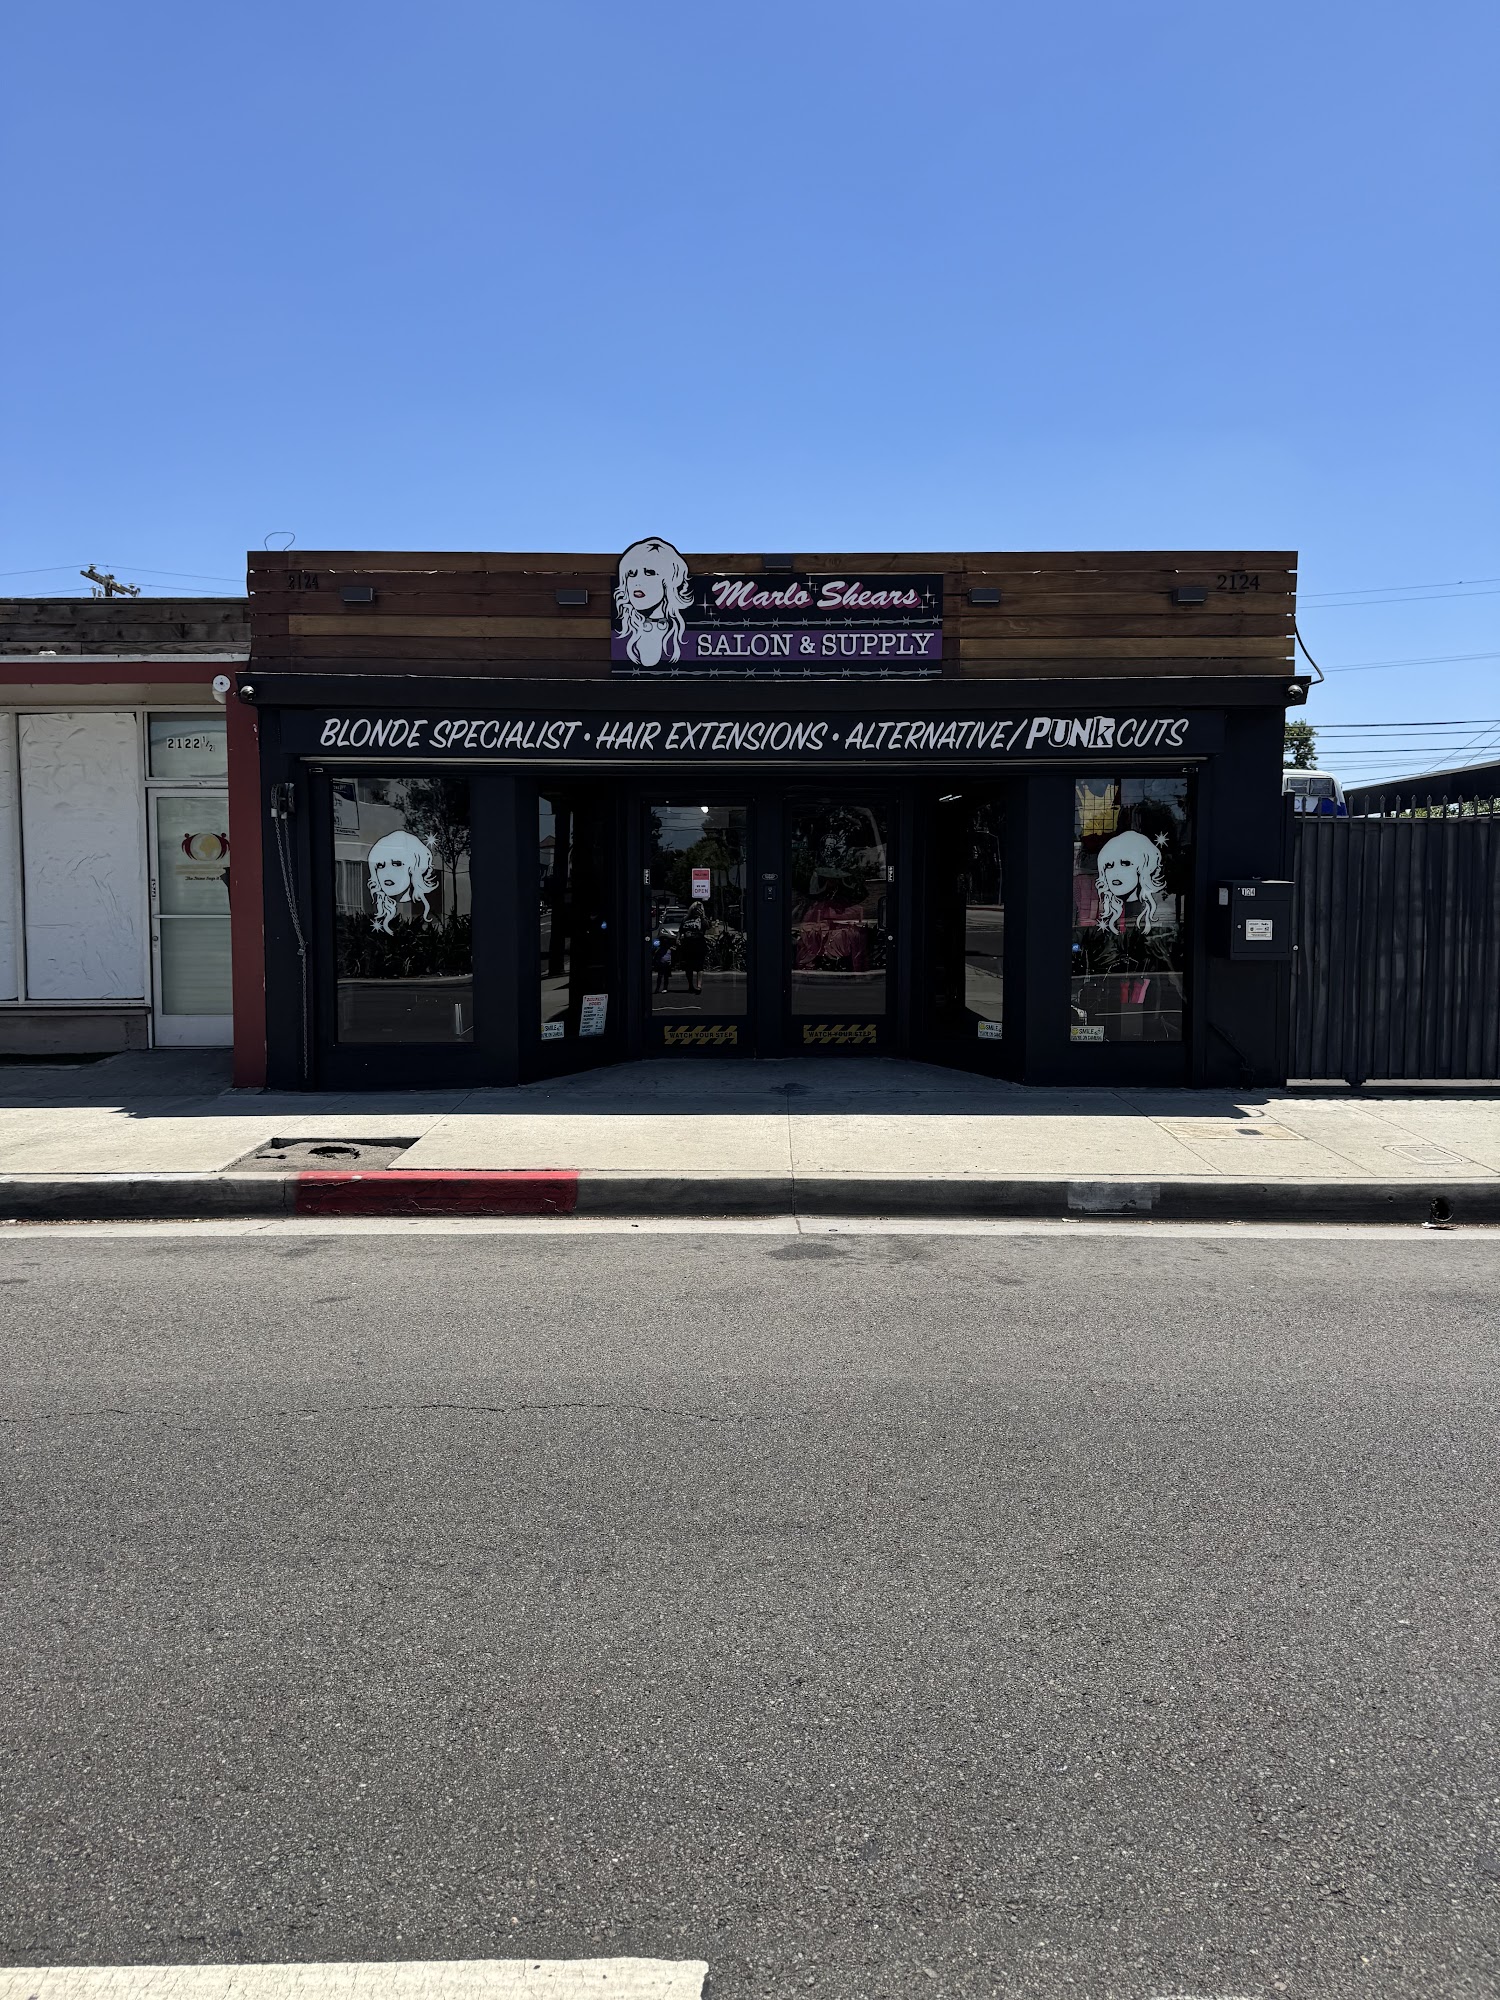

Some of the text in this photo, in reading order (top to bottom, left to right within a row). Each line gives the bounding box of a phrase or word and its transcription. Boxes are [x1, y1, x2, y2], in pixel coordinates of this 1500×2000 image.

[288, 573, 320, 590] 2124
[1216, 574, 1261, 591] 2124
[711, 580, 921, 610] Marlo Shears
[697, 632, 934, 656] SALON & SUPPLY
[320, 717, 428, 748] BLONDE
[428, 719, 583, 750] SPECIALIST
[595, 721, 662, 750] HAIR
[664, 721, 829, 751] EXTENSIONS
[1116, 718, 1190, 748] CUTS
[544, 1024, 557, 1032] SMILE
